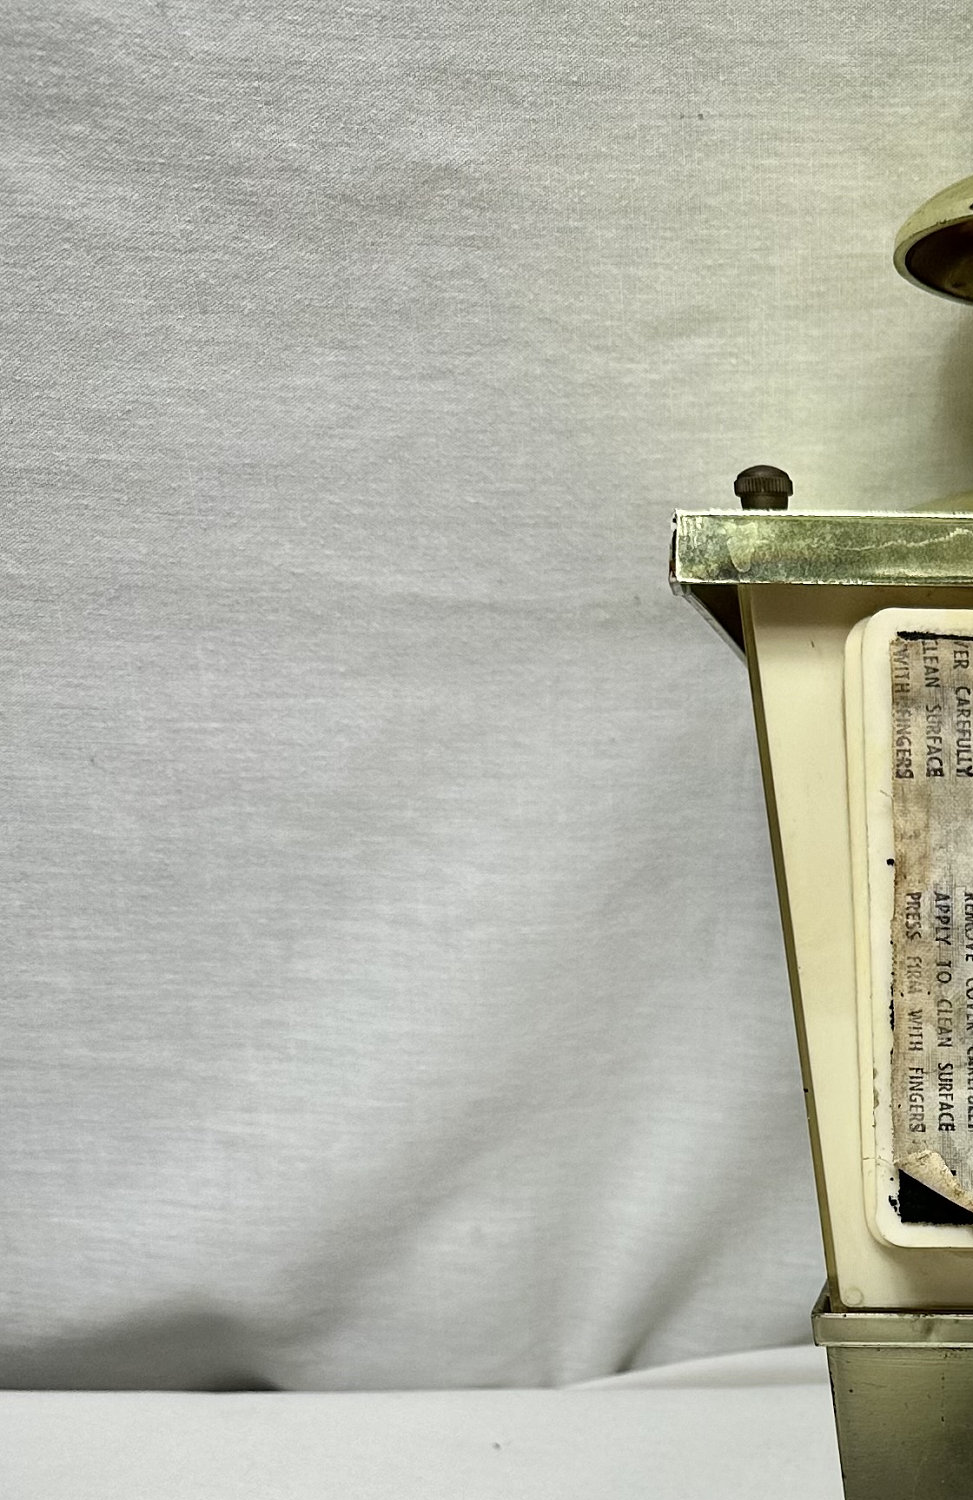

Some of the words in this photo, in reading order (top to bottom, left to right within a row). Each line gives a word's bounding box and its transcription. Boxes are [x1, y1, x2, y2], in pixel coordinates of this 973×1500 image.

[926, 703, 945, 778] SURFACE
[955, 685, 973, 778] CAREFULLY
[905, 891, 922, 941] PRESS
[934, 891, 951, 946] APPLY
[936, 960, 952, 985] TO
[907, 1008, 924, 1051] WITH
[937, 999, 953, 1048] CLEAN
[908, 1066, 926, 1133] FINGERS
[937, 1062, 955, 1132] SURFACE
